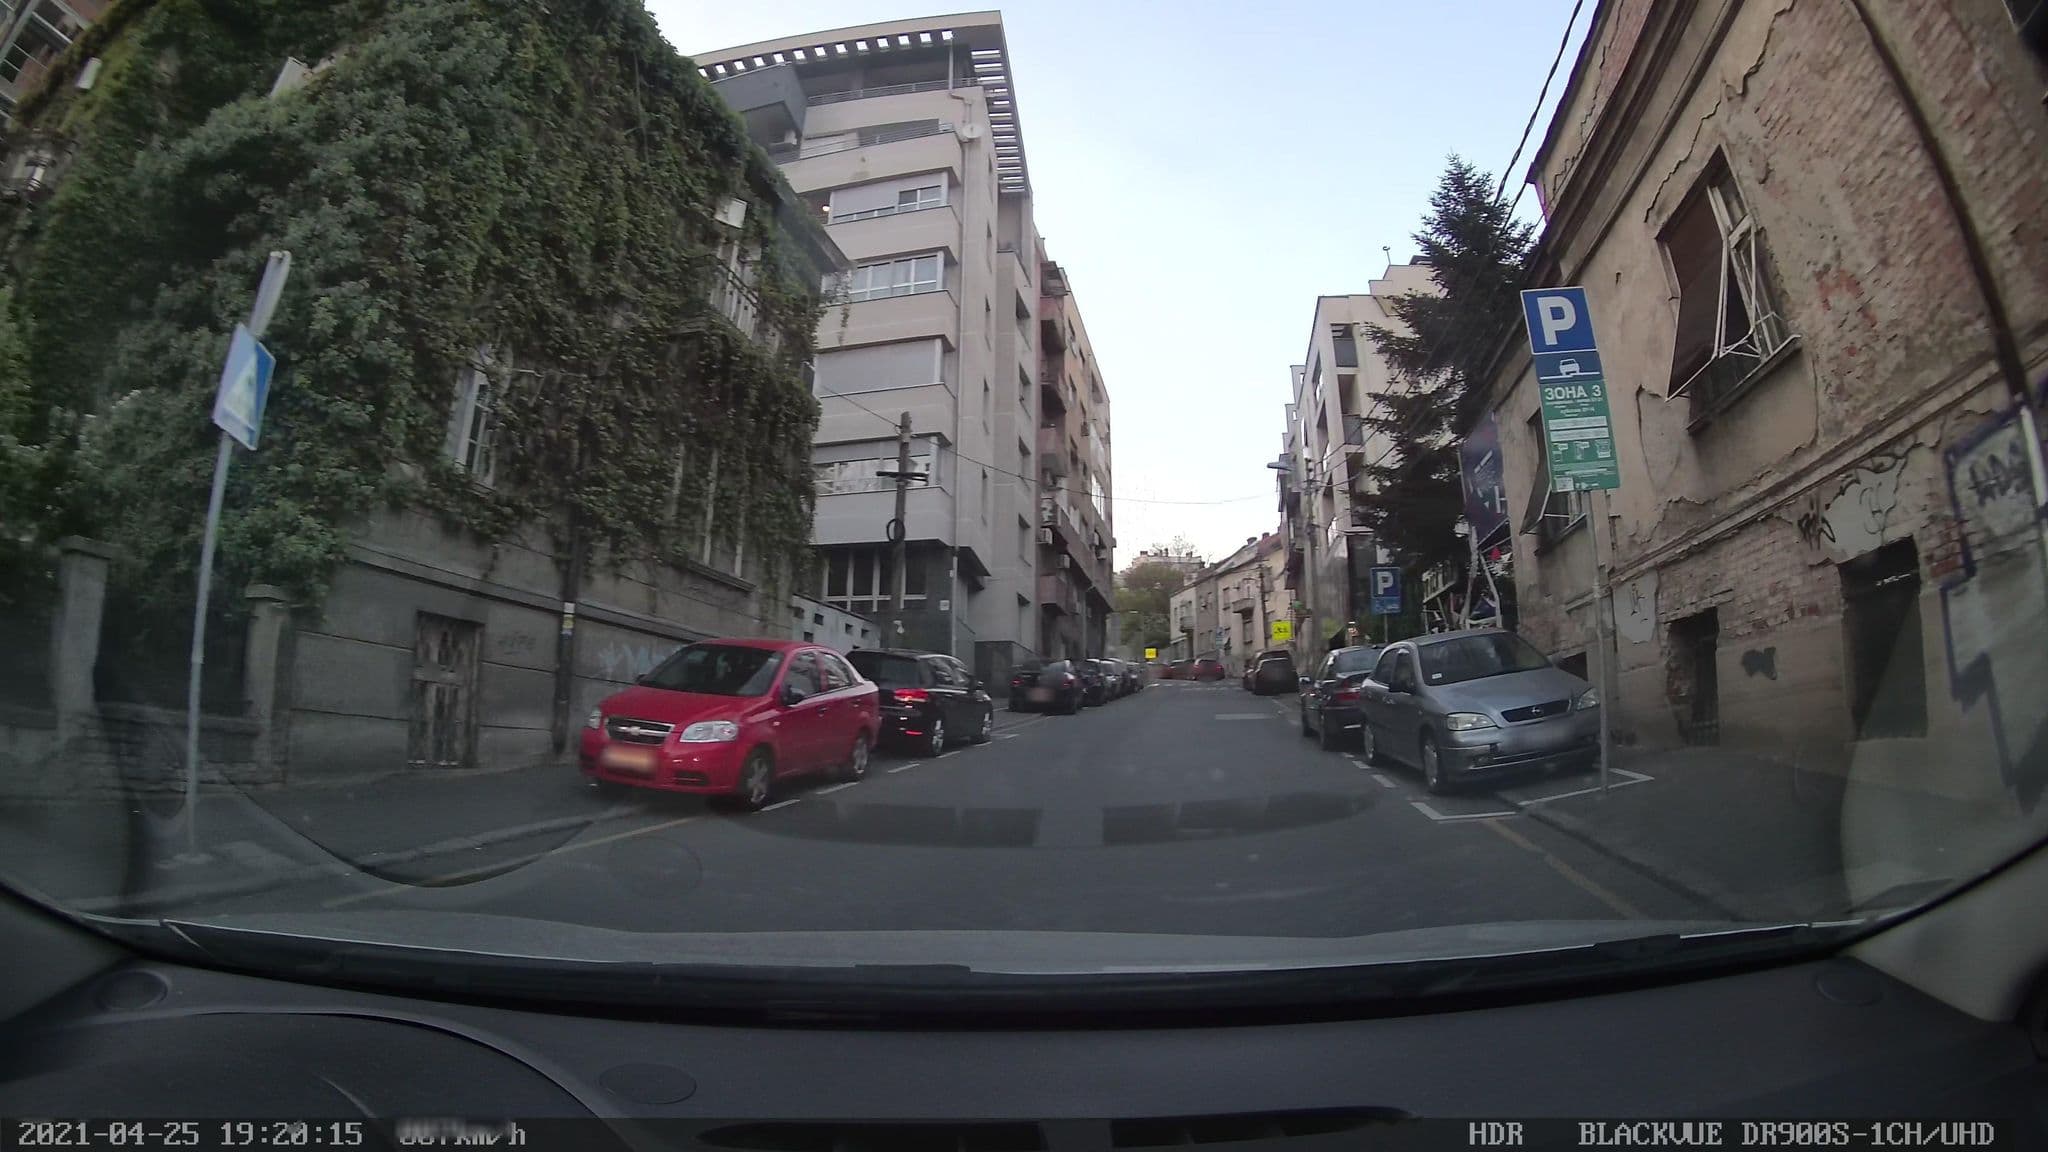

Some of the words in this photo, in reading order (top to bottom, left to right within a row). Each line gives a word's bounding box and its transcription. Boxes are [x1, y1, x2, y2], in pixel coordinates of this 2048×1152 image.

[1537, 296, 1576, 345] P
[1544, 386, 1588, 400] ЗОНА
[1592, 384, 1602, 397] 3
[1377, 571, 1393, 595] P
